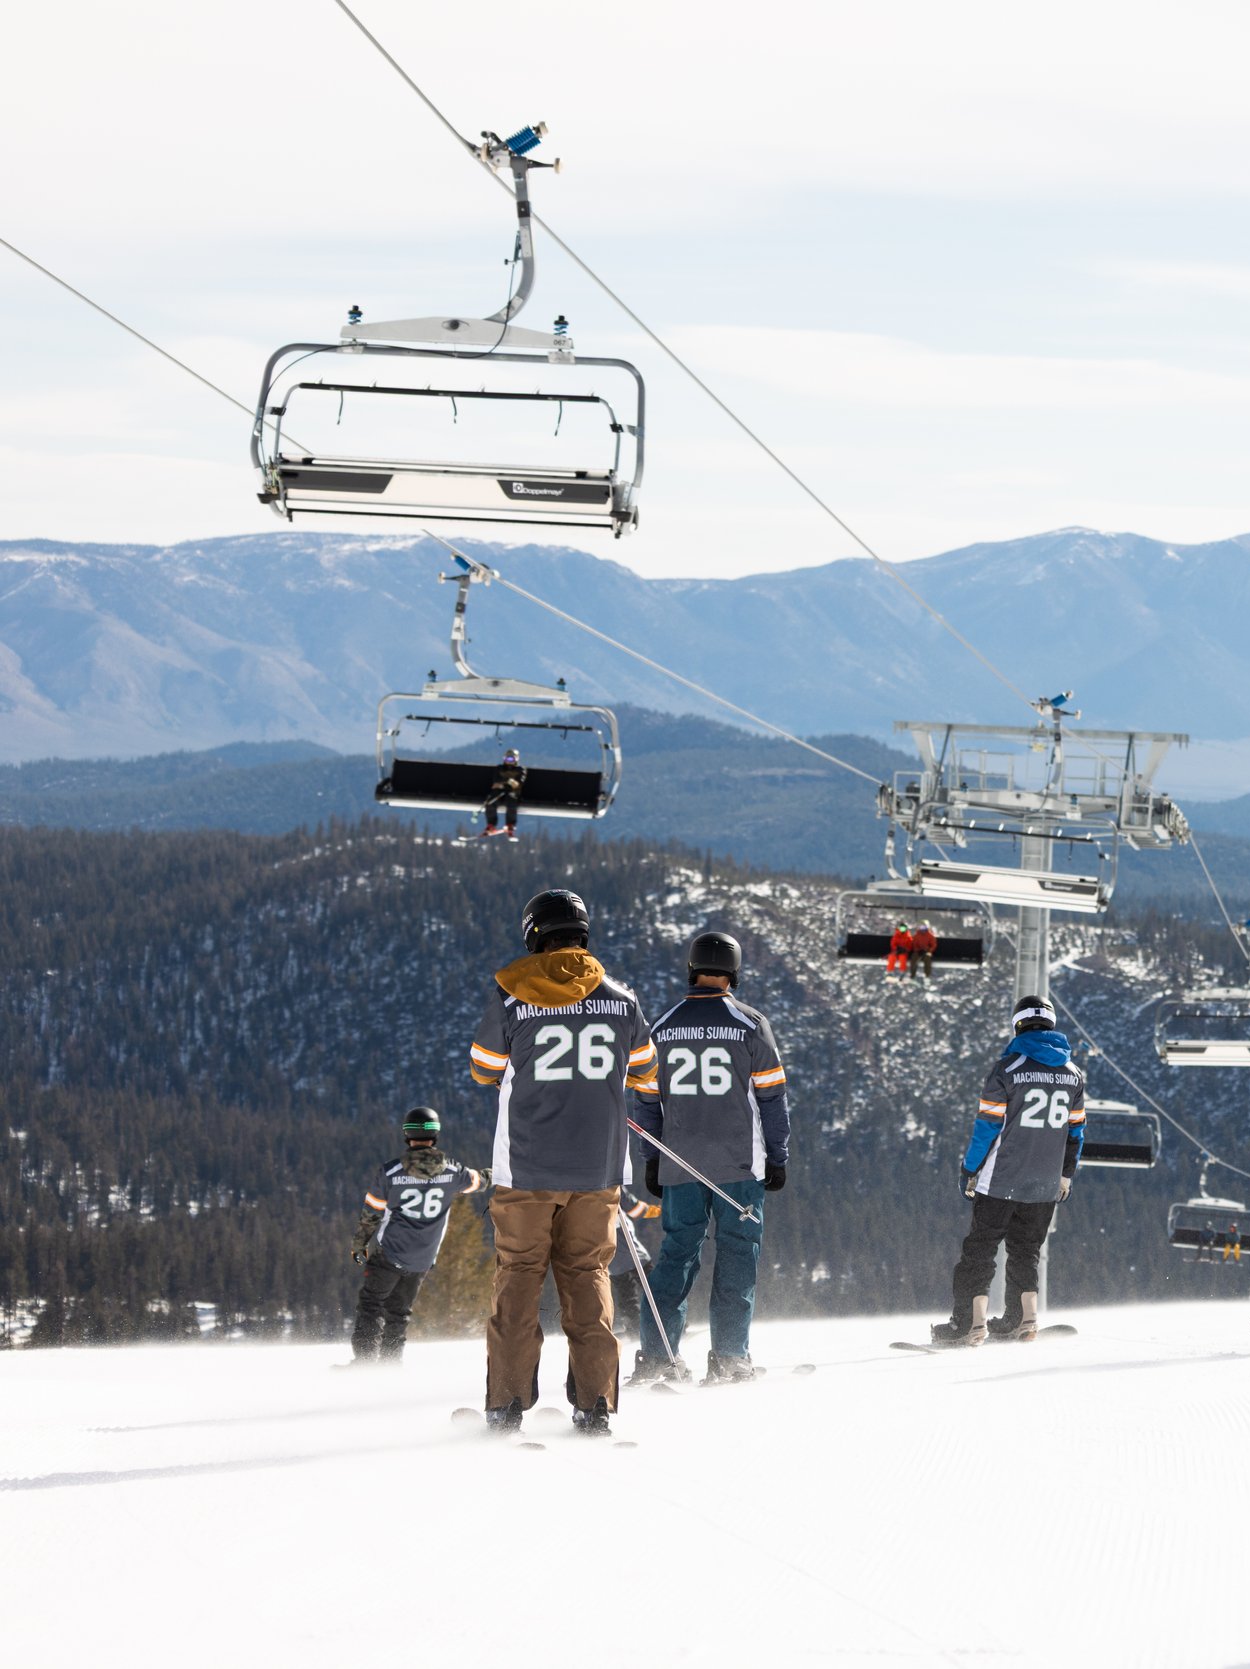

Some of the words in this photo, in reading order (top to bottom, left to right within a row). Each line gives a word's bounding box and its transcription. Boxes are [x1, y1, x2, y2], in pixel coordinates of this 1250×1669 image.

[585, 999, 628, 1017] SUMMIT
[706, 1026, 746, 1042] SUMMIT
[534, 1023, 616, 1081] 26
[667, 1047, 732, 1095] 26
[1013, 1071, 1054, 1084] MACHINING
[1020, 1088, 1070, 1129] 26
[400, 1187, 445, 1219] 26
